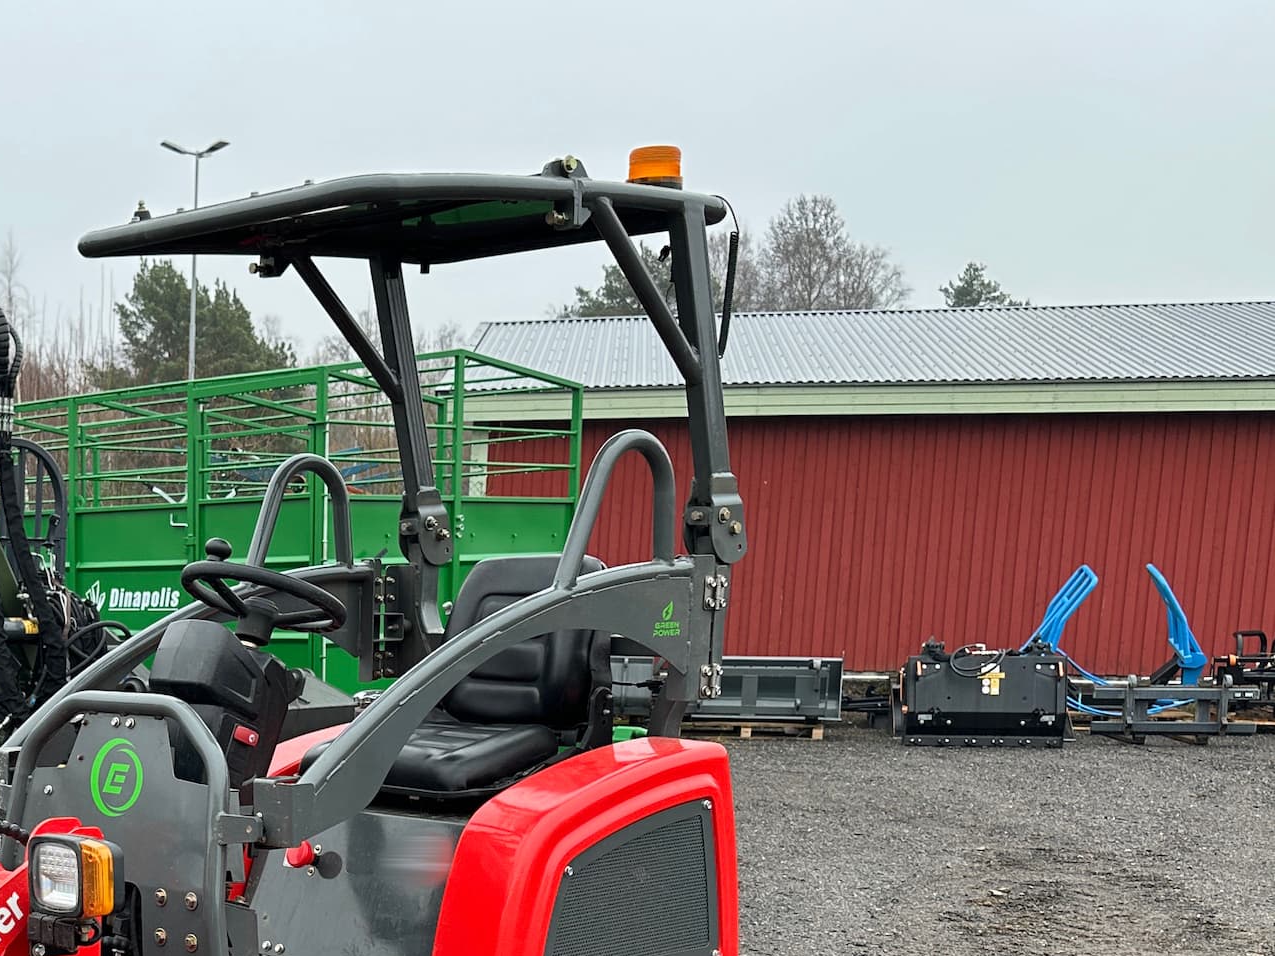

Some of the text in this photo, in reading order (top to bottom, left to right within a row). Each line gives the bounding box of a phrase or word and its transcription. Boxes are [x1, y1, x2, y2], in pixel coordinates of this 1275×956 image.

[109, 587, 180, 611] Dinapolis
[654, 621, 680, 629] GREEN
[653, 629, 681, 637] POWER
